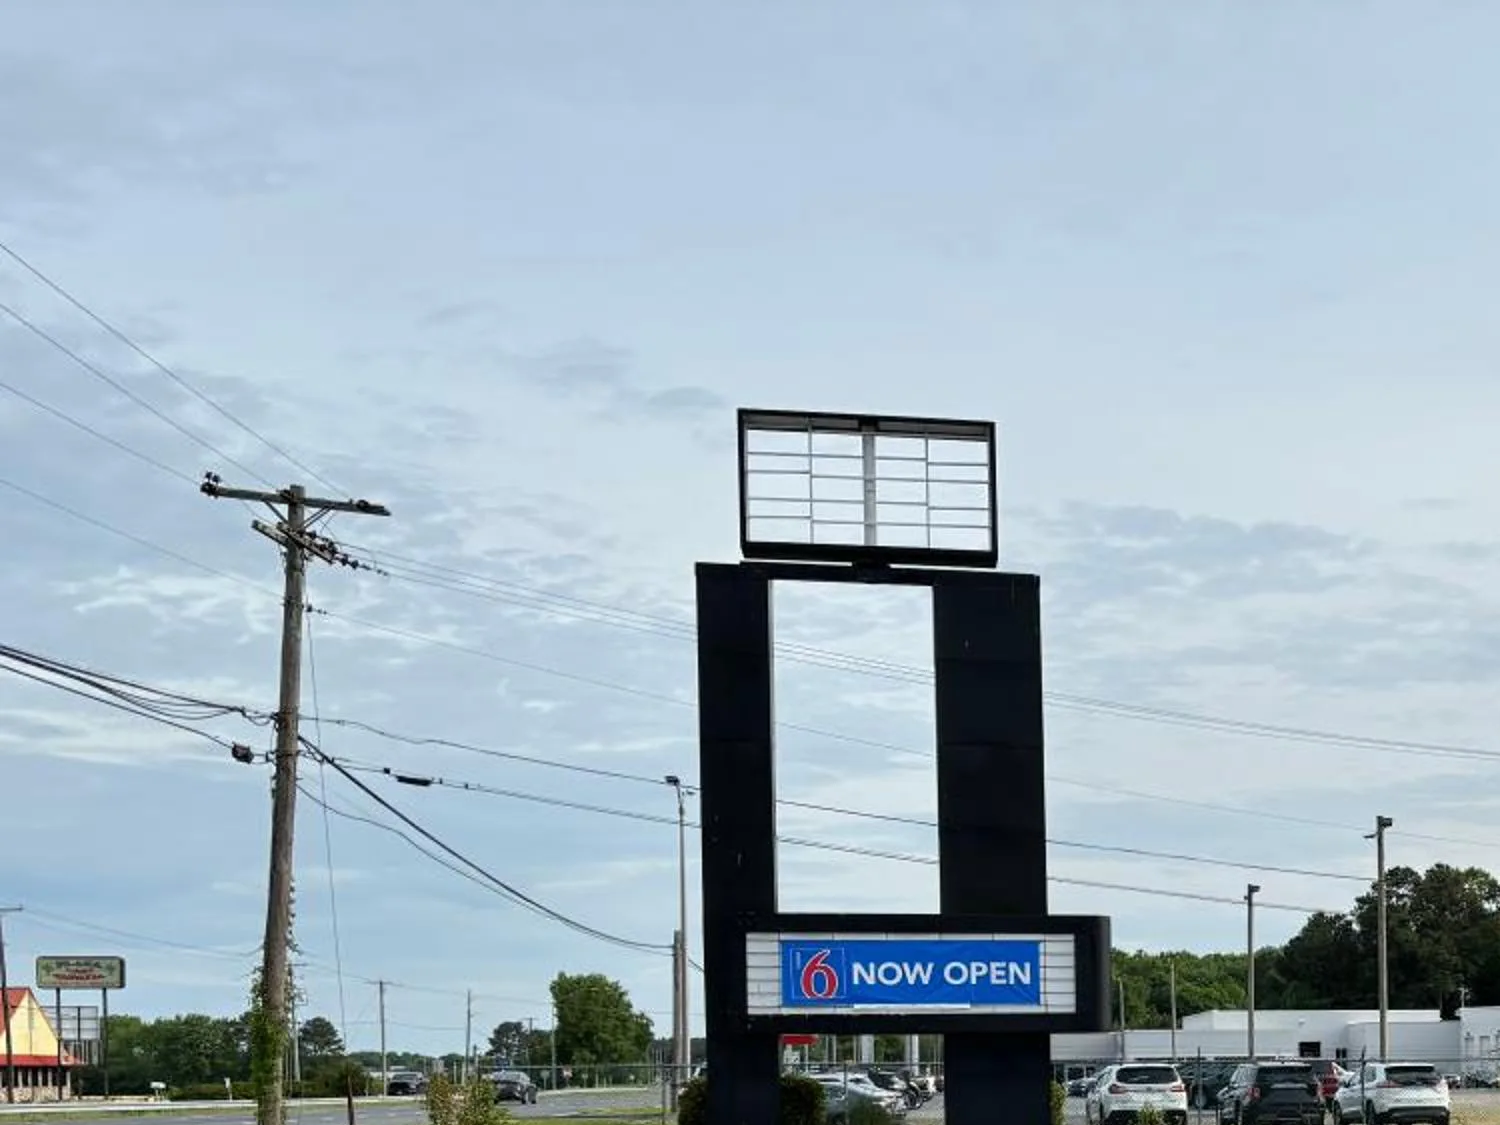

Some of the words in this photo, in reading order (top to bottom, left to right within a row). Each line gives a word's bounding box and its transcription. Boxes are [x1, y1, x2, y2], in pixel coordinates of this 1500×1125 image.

[801, 949, 838, 999] 6
[852, 961, 934, 986] NOW
[943, 961, 1031, 986] OPEN
